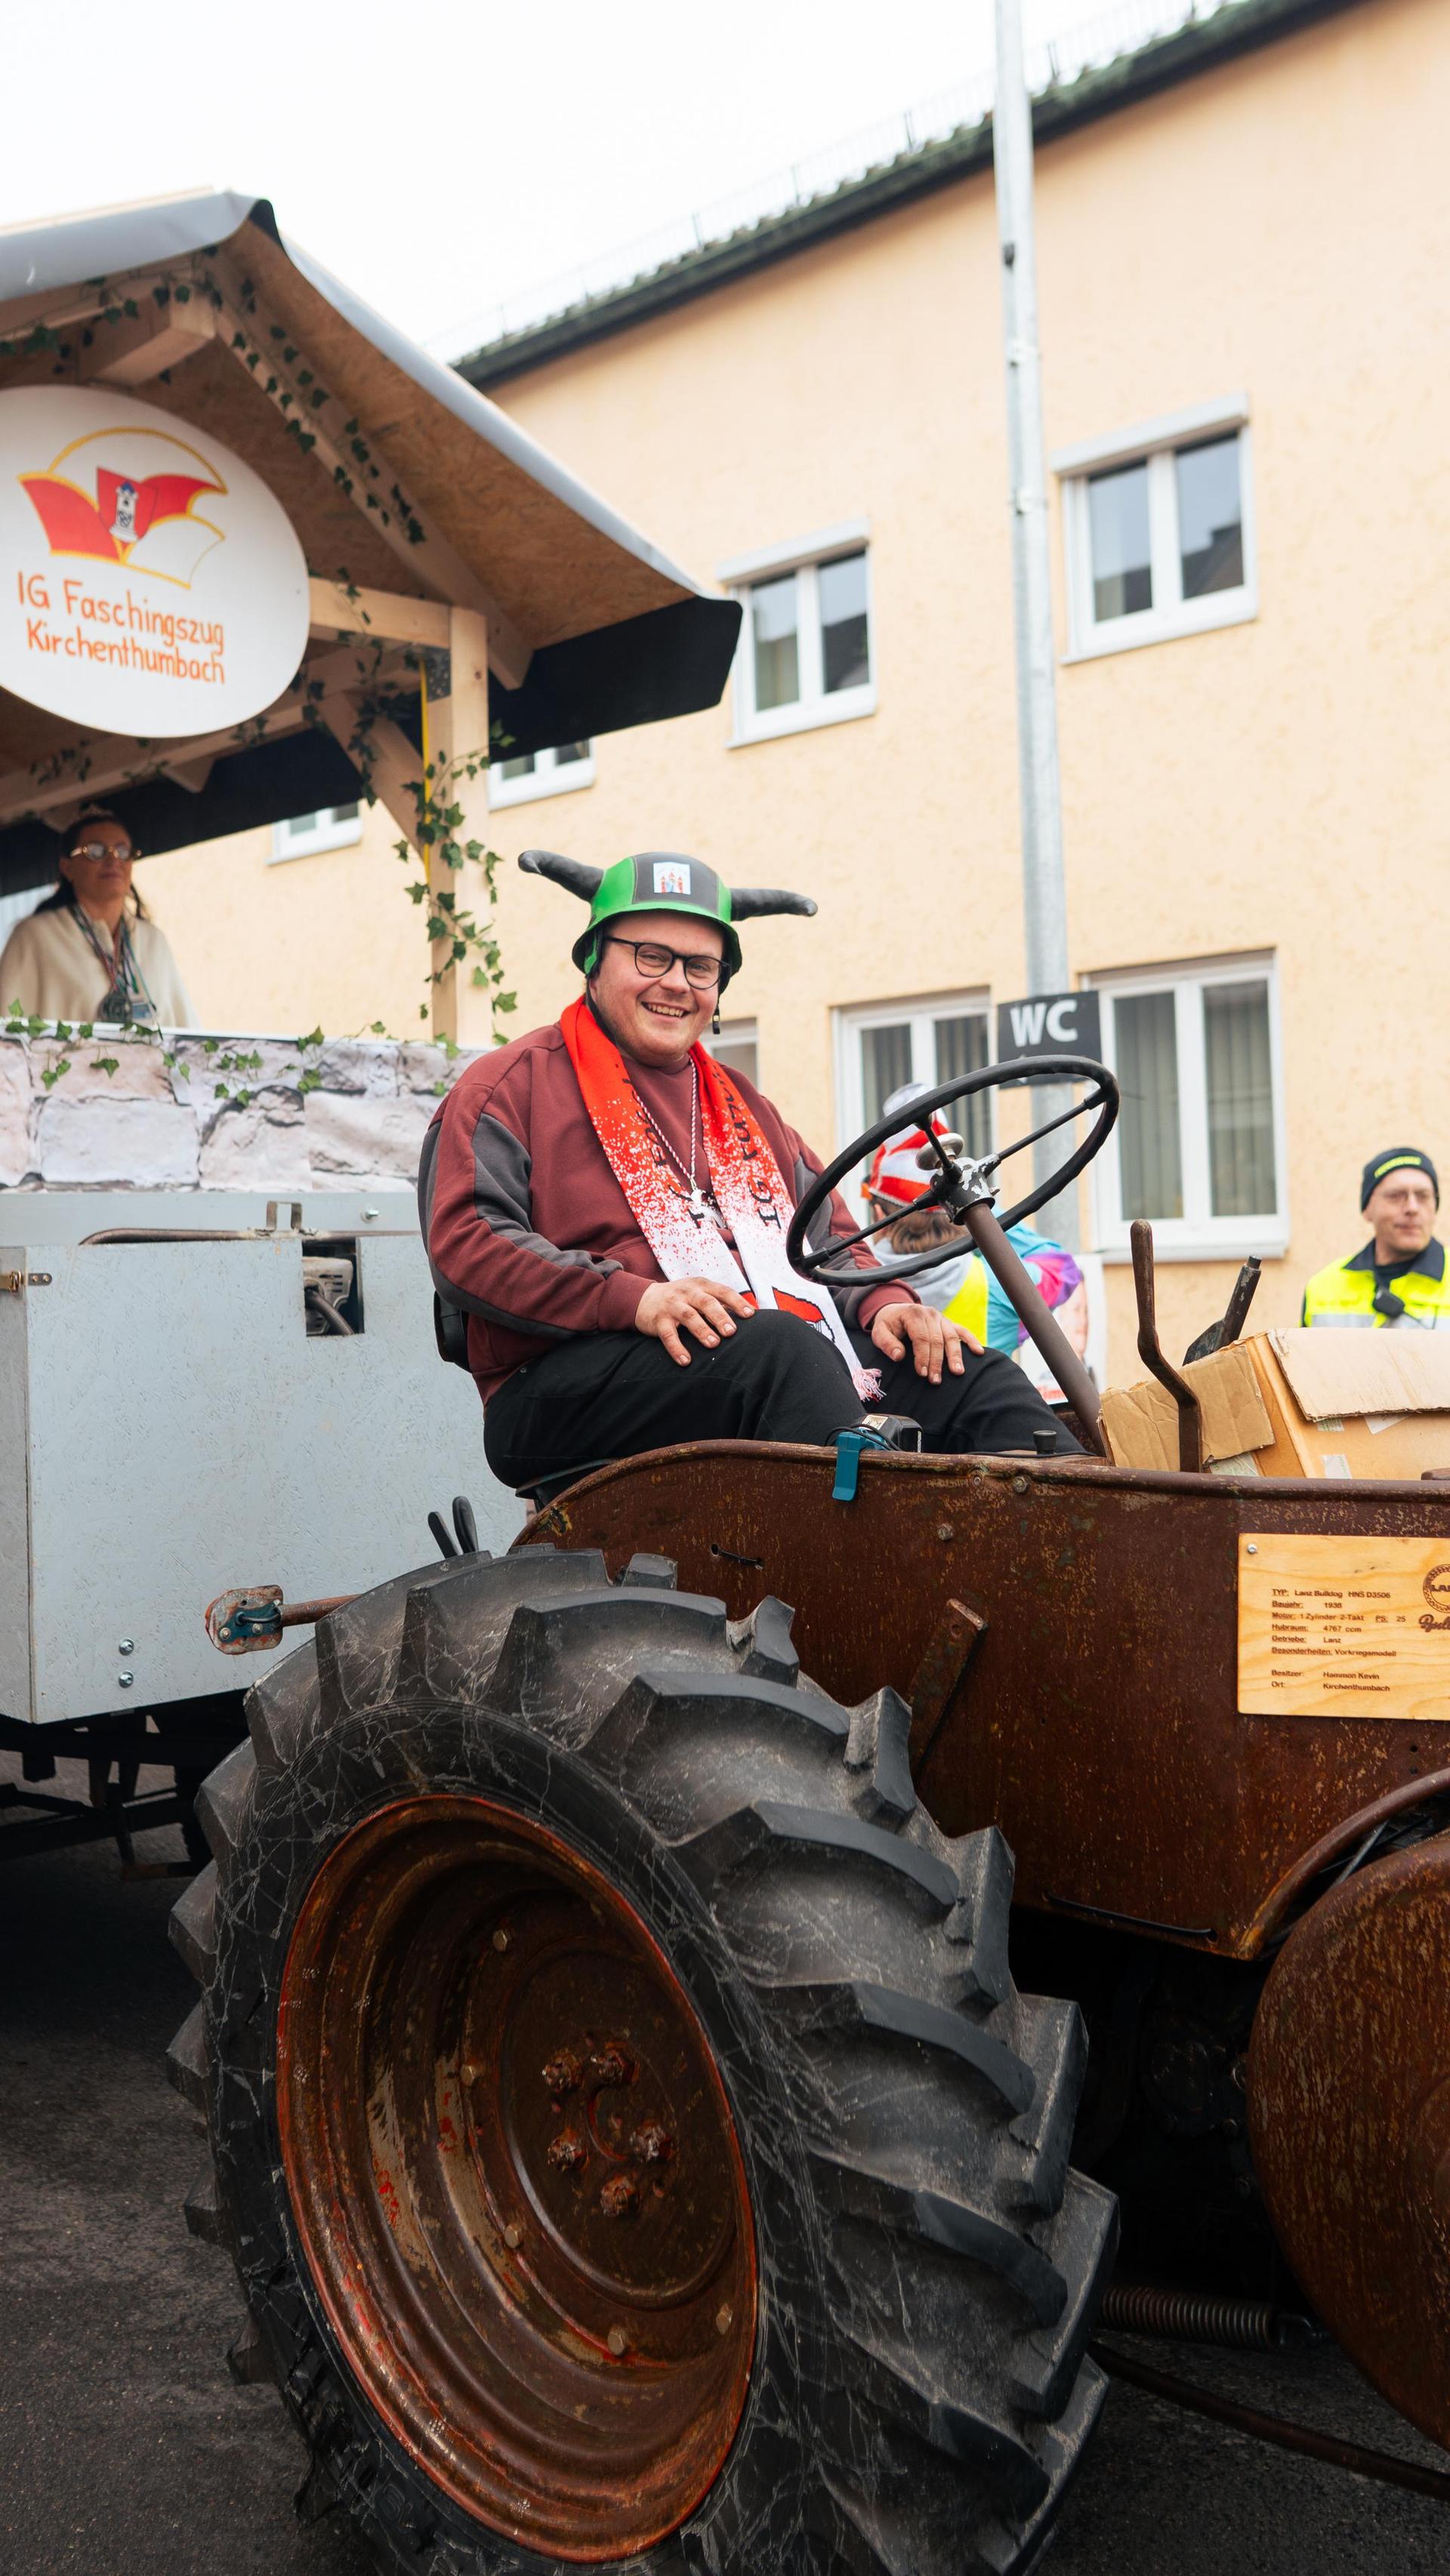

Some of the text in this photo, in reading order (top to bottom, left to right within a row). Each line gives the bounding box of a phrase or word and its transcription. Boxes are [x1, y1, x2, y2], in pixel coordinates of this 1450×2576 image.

[17, 571, 225, 656] IG Faschingszug
[26, 618, 226, 685] Kirchenthumbach
[1009, 999, 1079, 1048] WC
[1314, 1590, 1343, 1598] Bulldog
[1305, 1613, 1337, 1622] Zylinder
[1334, 1648, 1397, 1657] Vorkriegsmodell
[1323, 1683, 1390, 1691] Kirchenthumbach
